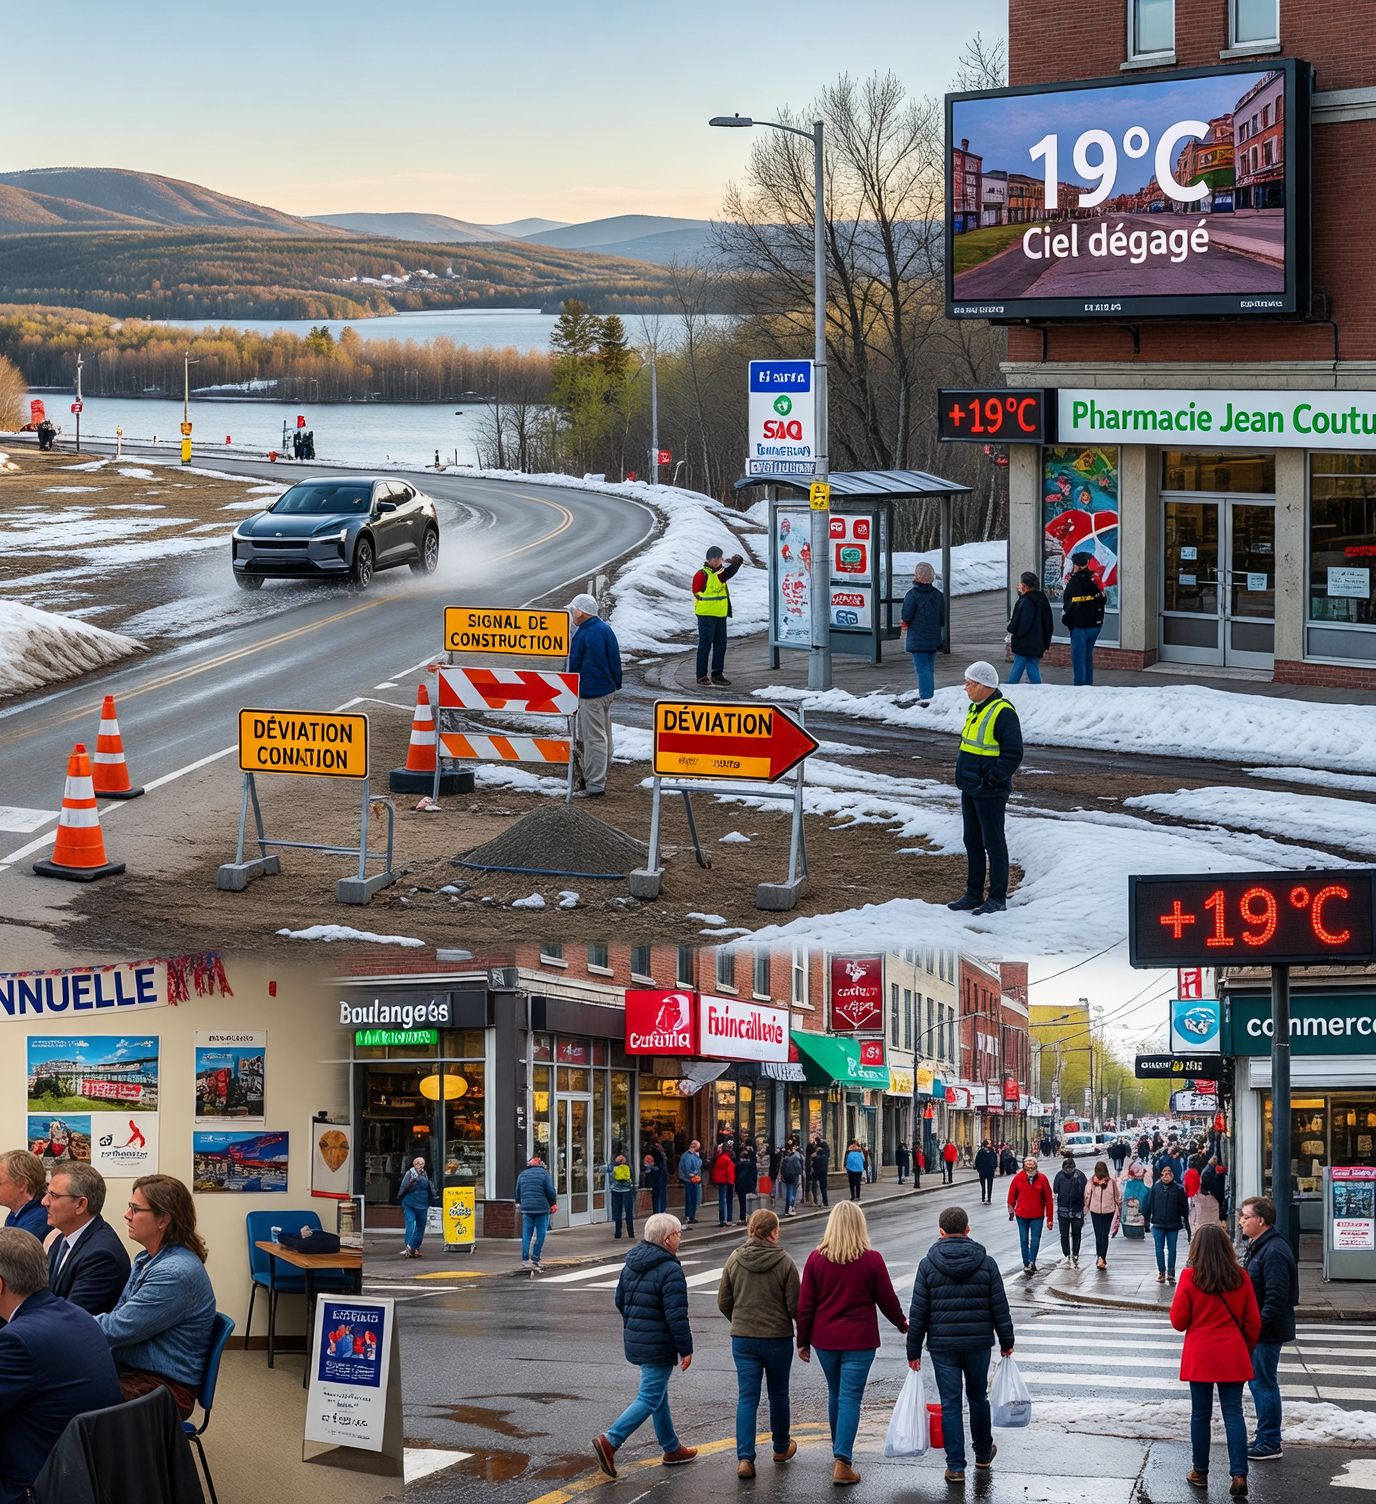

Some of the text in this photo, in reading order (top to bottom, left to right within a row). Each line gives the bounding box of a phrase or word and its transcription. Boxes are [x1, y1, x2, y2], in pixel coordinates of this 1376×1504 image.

[1029, 120, 1211, 210] 19°C
[1023, 218, 1209, 264] Ciel dégagé
[948, 397, 1037, 434] +19°C
[1072, 400, 1376, 435] Pharmacie Jean Coutu
[468, 614, 548, 630] SIGNAL DE
[450, 632, 563, 651] CONSTRUCTION
[254, 716, 352, 743] DÉVIATION
[663, 705, 772, 736] DÉVIATION
[1160, 886, 1351, 946] +19°C
[1246, 1016, 1376, 1037] commerc
